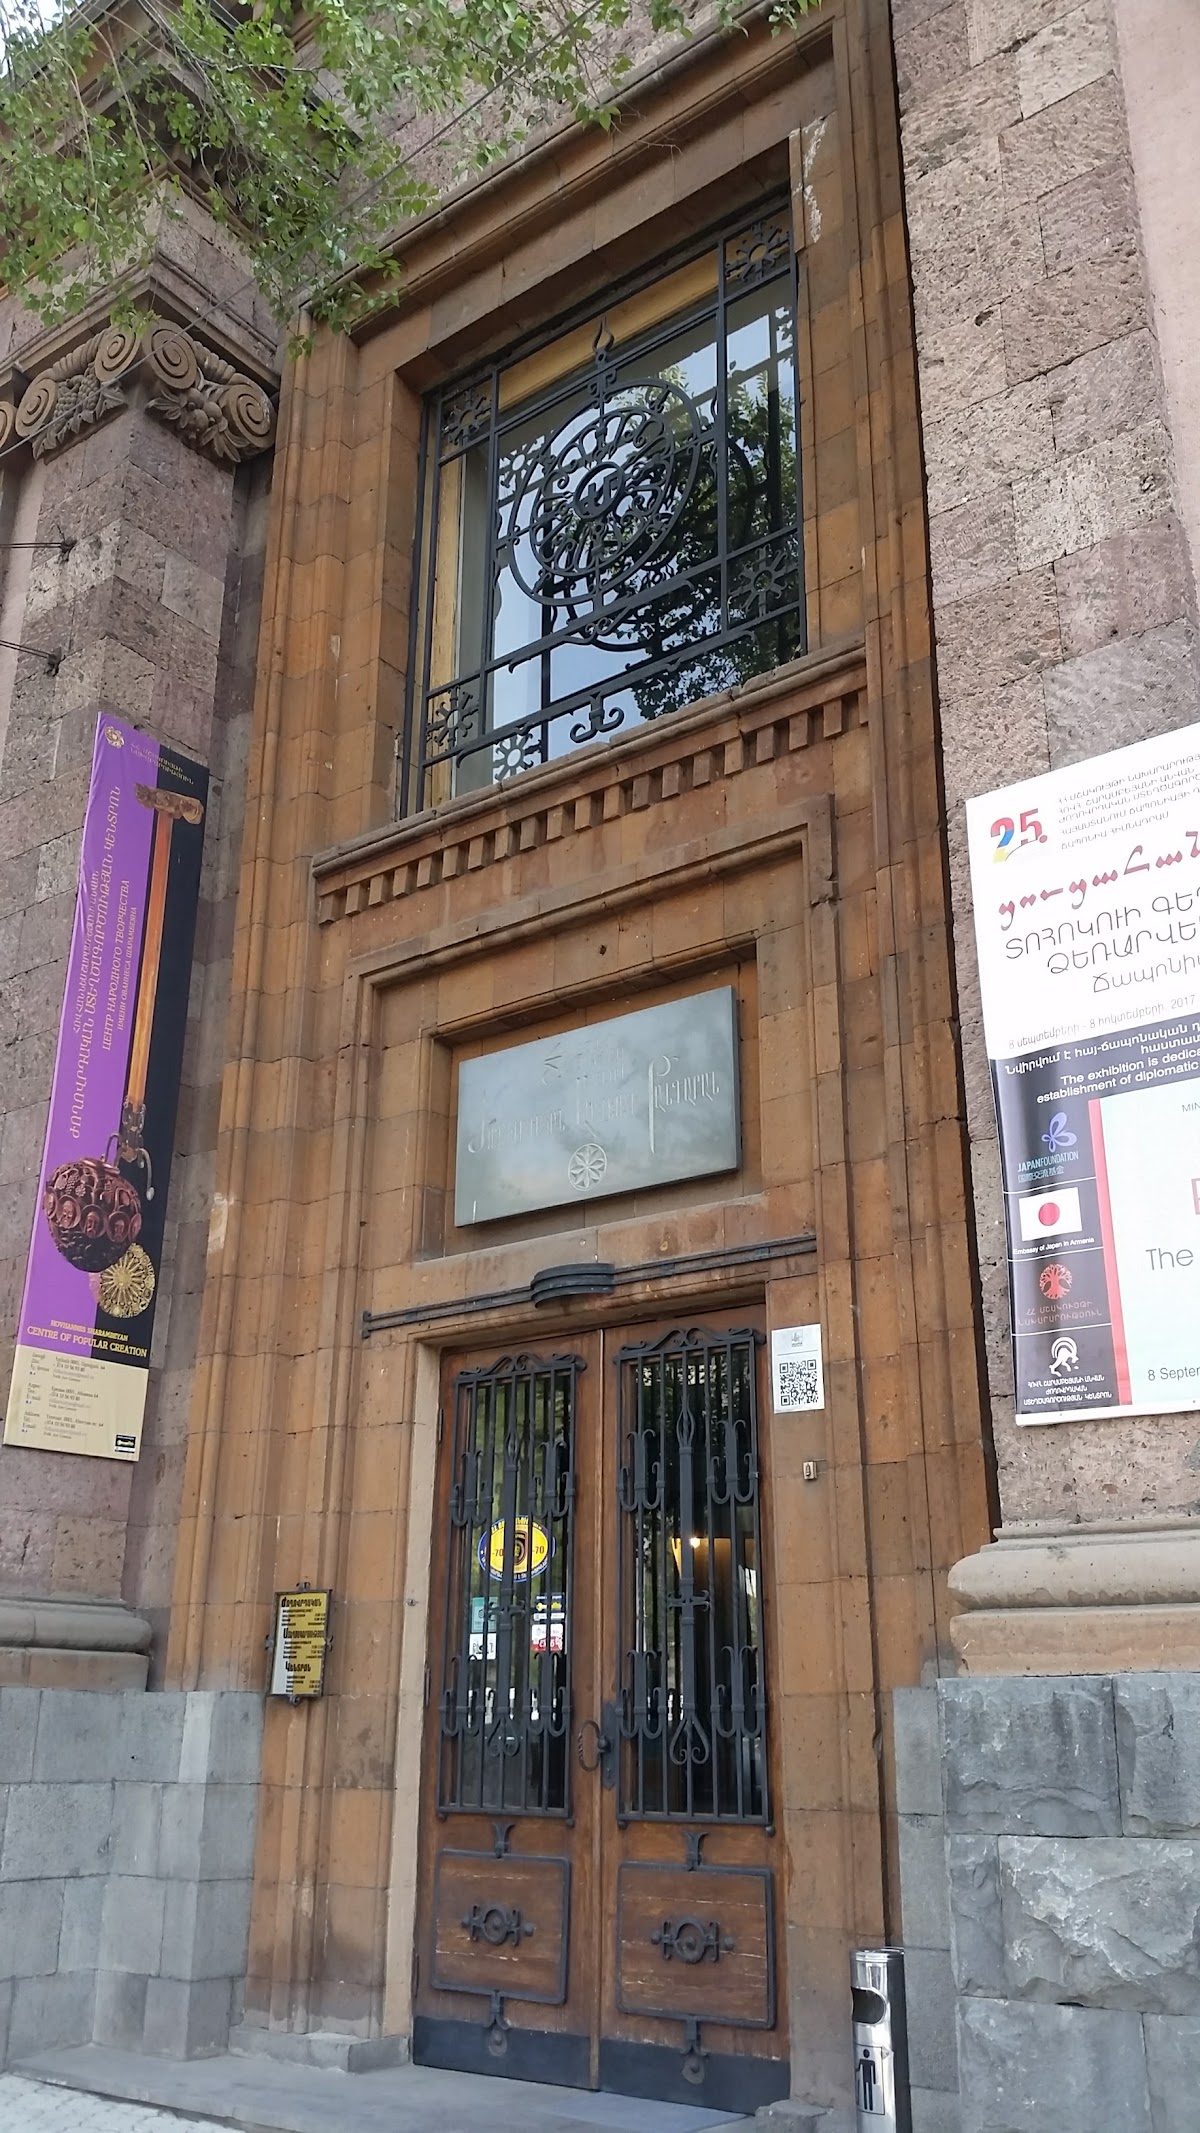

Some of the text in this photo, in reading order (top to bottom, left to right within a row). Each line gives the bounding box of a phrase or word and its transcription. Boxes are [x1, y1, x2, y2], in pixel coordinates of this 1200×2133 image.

[1005, 907, 1141, 959] ՏՈՀՈԿՈՒԻ
[1047, 917, 1200, 974] ՁԵՌԱՐՎԵ
[70, 786, 121, 1138] ԺՈՂՈՎՐԴԱԿԱՆ ՍՏԵՂԾԱԳՈՐԾՈՒԹՅԱՆ ԿԵՆՏՐՈՆ
[102, 880, 130, 1051] ЦЕНТР НАРОДНОГО ТВОРЧЕСТВА
[1093, 954, 1200, 992] Ճապոնի
[1171, 994, 1196, 1010] 2017
[1005, 1053, 1060, 1075] Նվիրվում
[1060, 1073, 1084, 1087] The
[1088, 1059, 1144, 1081] exhibition
[1148, 1056, 1159, 1067] is
[1036, 1060, 1199, 1104] establishment of diplomatic
[1013, 1245, 1039, 1255] Embassy
[1039, 1244, 1046, 1252] of
[1046, 1242, 1062, 1251] Japan
[1070, 1236, 1095, 1247] Armenia
[1145, 1248, 1194, 1271] The
[27, 1326, 147, 1357] CENTRE OF POPULAR CREATION
[51, 1320, 86, 1332] HOVHANNES
[1148, 1369, 1156, 1381] 8
